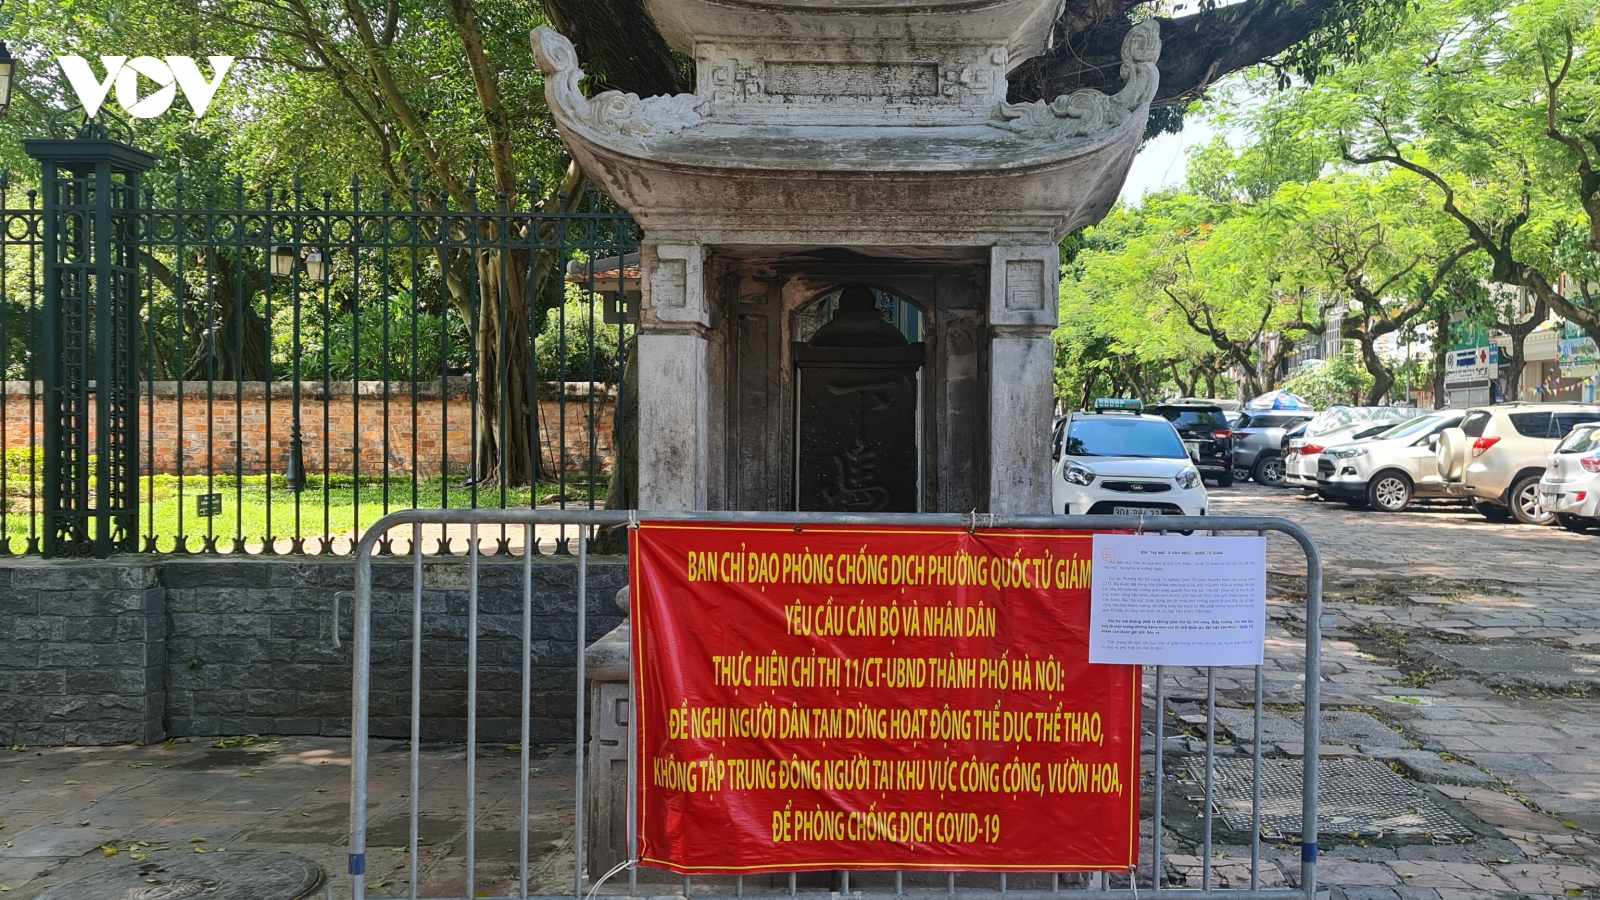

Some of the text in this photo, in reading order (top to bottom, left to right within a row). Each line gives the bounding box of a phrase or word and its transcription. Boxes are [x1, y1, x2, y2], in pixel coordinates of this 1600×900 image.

[688, 542, 1091, 594] BAN CHỈ ĐẠO PHÒNG CHỐNG DỊCH PHƯỜNG QUỐC TỬ GIÁM
[785, 596, 996, 645] YÊU CẦU CÁN BỘ VÀ NHÂN DÂN
[712, 647, 1065, 700] THỰC HIỆN CHỈ THỊ 11/CT-UBND THÀNH PHỐ HÀ NỘI:
[669, 698, 1104, 751] ĐỀ NGHỊ NGƯỜI DÂN TẠM DỪNG HOẠT ĐỘNG THỂ DỤC THỂ THAO,
[653, 752, 1123, 801] KHÔNG TẬP TRUNG ĐÔNG NGƯỜI TẠI KHU VỰC CÔNG CỘNG, VƯỜN HOA,
[772, 799, 1000, 851] ĐỂ PHÒNG CHỐNG DỊCH COVID-19
